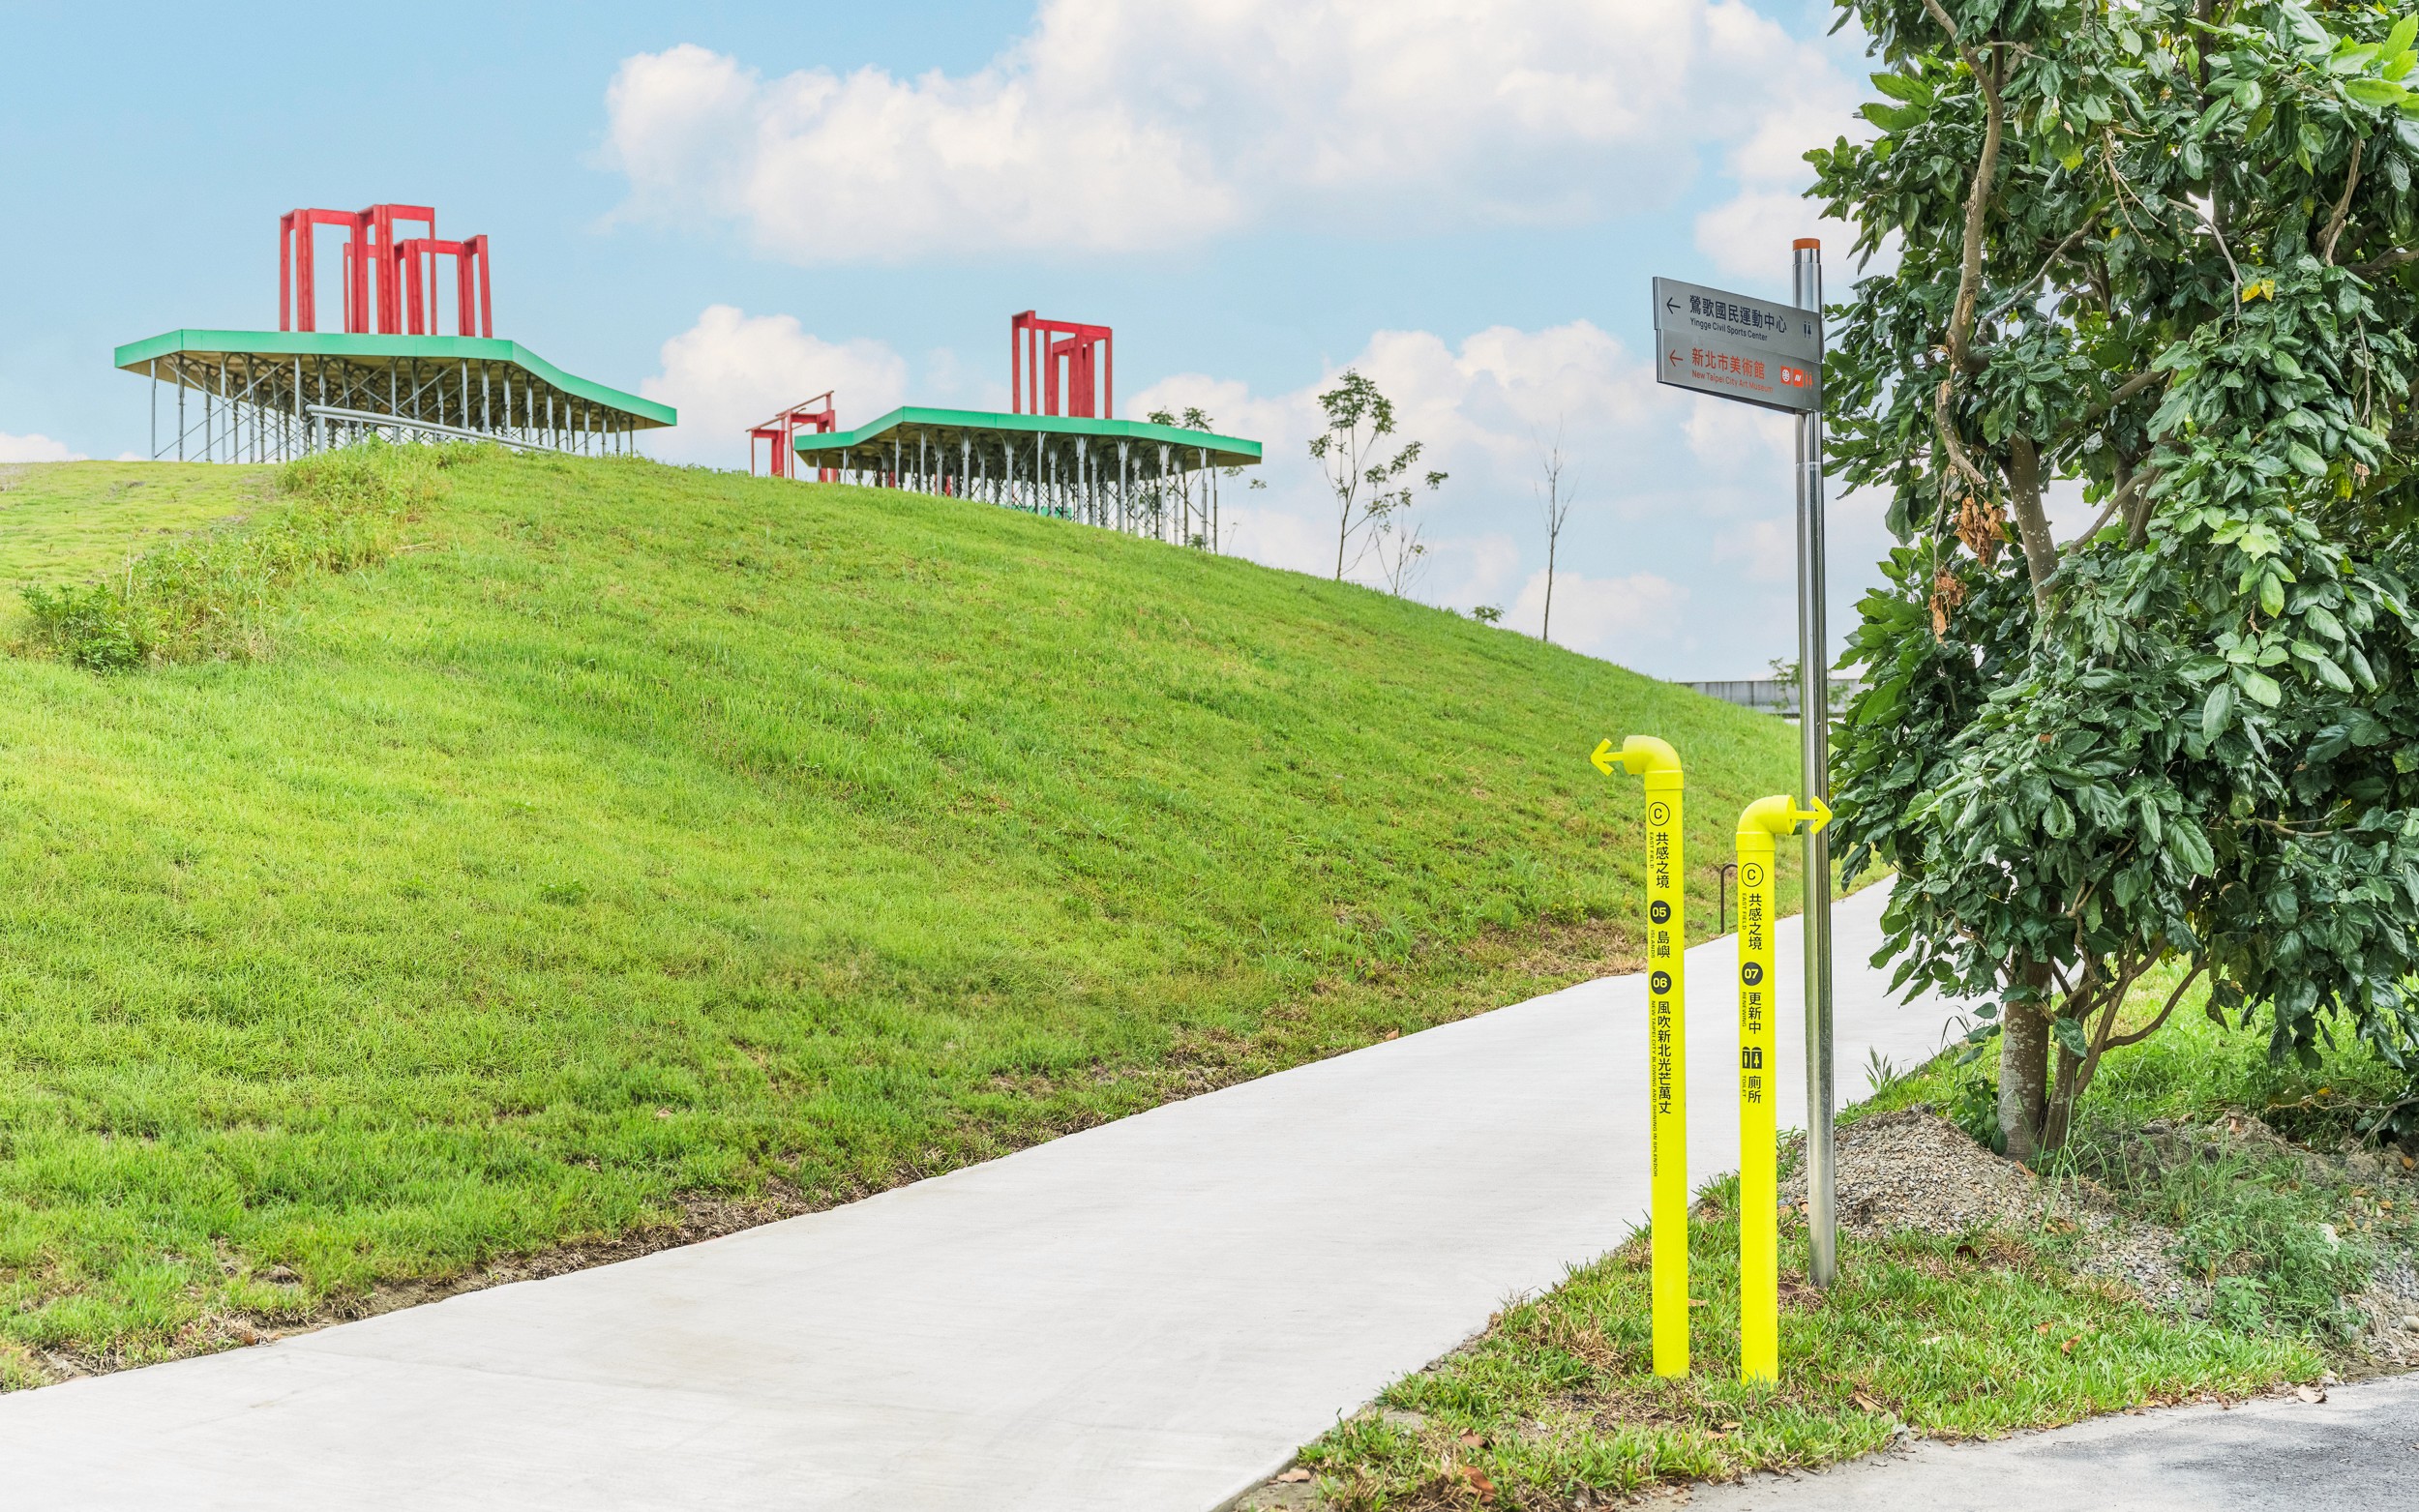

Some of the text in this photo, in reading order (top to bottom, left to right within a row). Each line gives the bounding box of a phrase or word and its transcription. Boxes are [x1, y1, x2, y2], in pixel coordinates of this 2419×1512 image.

[1689, 295, 1787, 333] 鶯歌國民運動中心
[1690, 317, 1768, 341] Yingge Civil Sports Center
[1691, 347, 1765, 380] 新北市美術館
[1692, 370, 1773, 393] New Taipei City Art Museum
[1656, 832, 1670, 889] 共感之境
[1652, 906, 1667, 917] 05
[1748, 893, 1762, 950] 共感之境
[1657, 930, 1670, 958] 島嶼
[1653, 977, 1668, 988] 06
[1744, 968, 1759, 979] 07
[1748, 992, 1761, 1034] 更新中
[1657, 1001, 1672, 1113] 風吹新北光芒萬丈
[1747, 1075, 1761, 1103] 廁所
